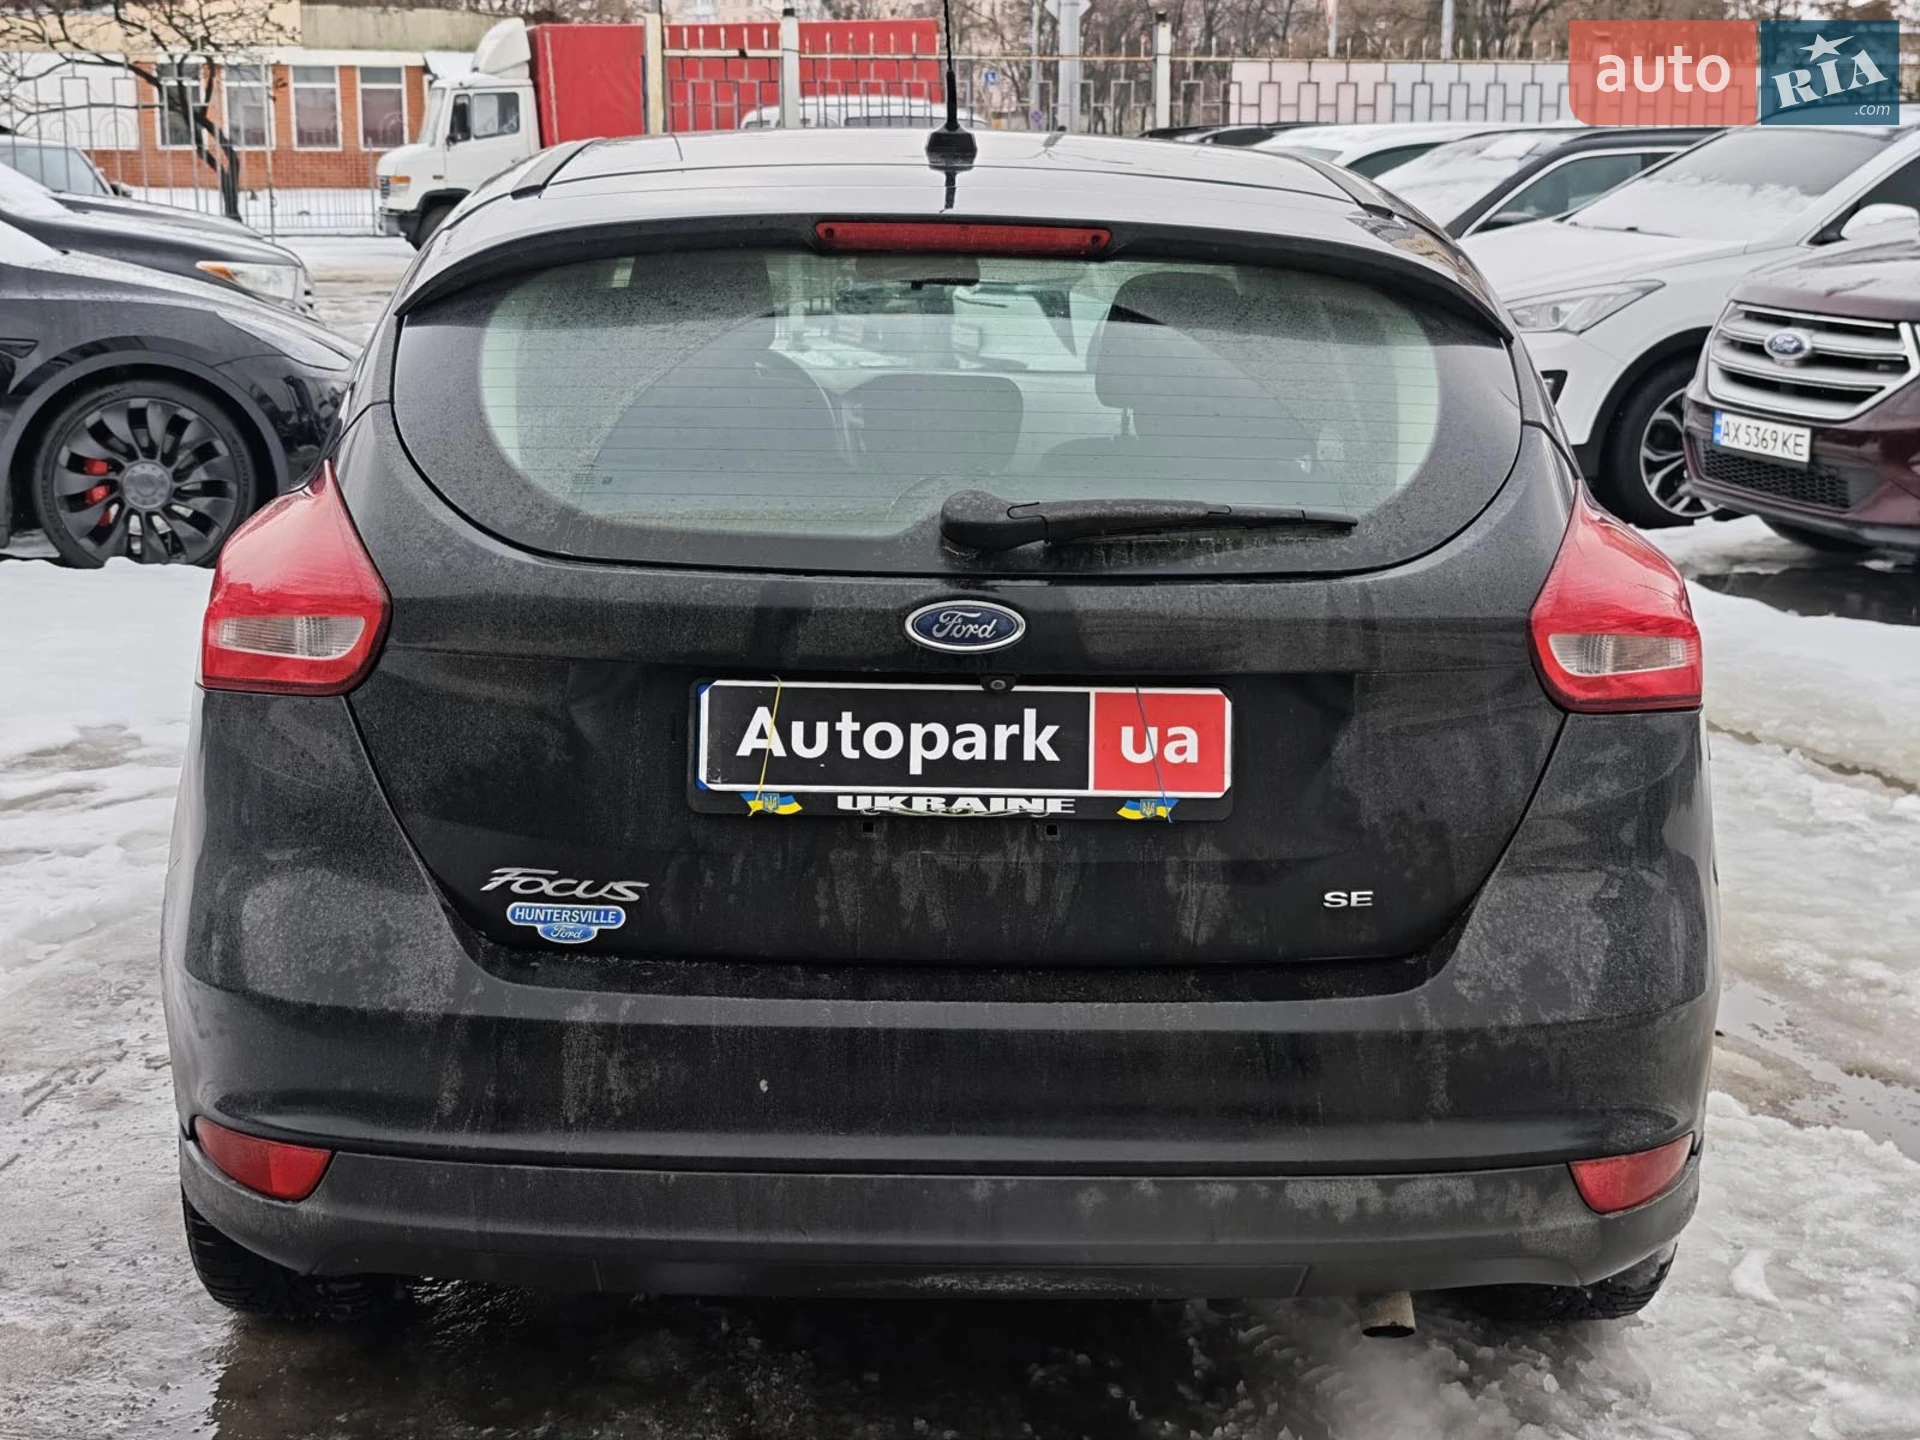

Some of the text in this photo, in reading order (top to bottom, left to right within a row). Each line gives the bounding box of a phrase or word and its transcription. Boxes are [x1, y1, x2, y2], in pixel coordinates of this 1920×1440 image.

[1722, 421, 1805, 457] AX 5369 KE
[932, 610, 997, 638] Ford
[736, 706, 1199, 774] Autopark ua
[837, 795, 1076, 814] UKRAINE
[1323, 891, 1373, 908] SE
[514, 907, 617, 924] HUNTERSVILLE
[550, 924, 583, 939] Ford
